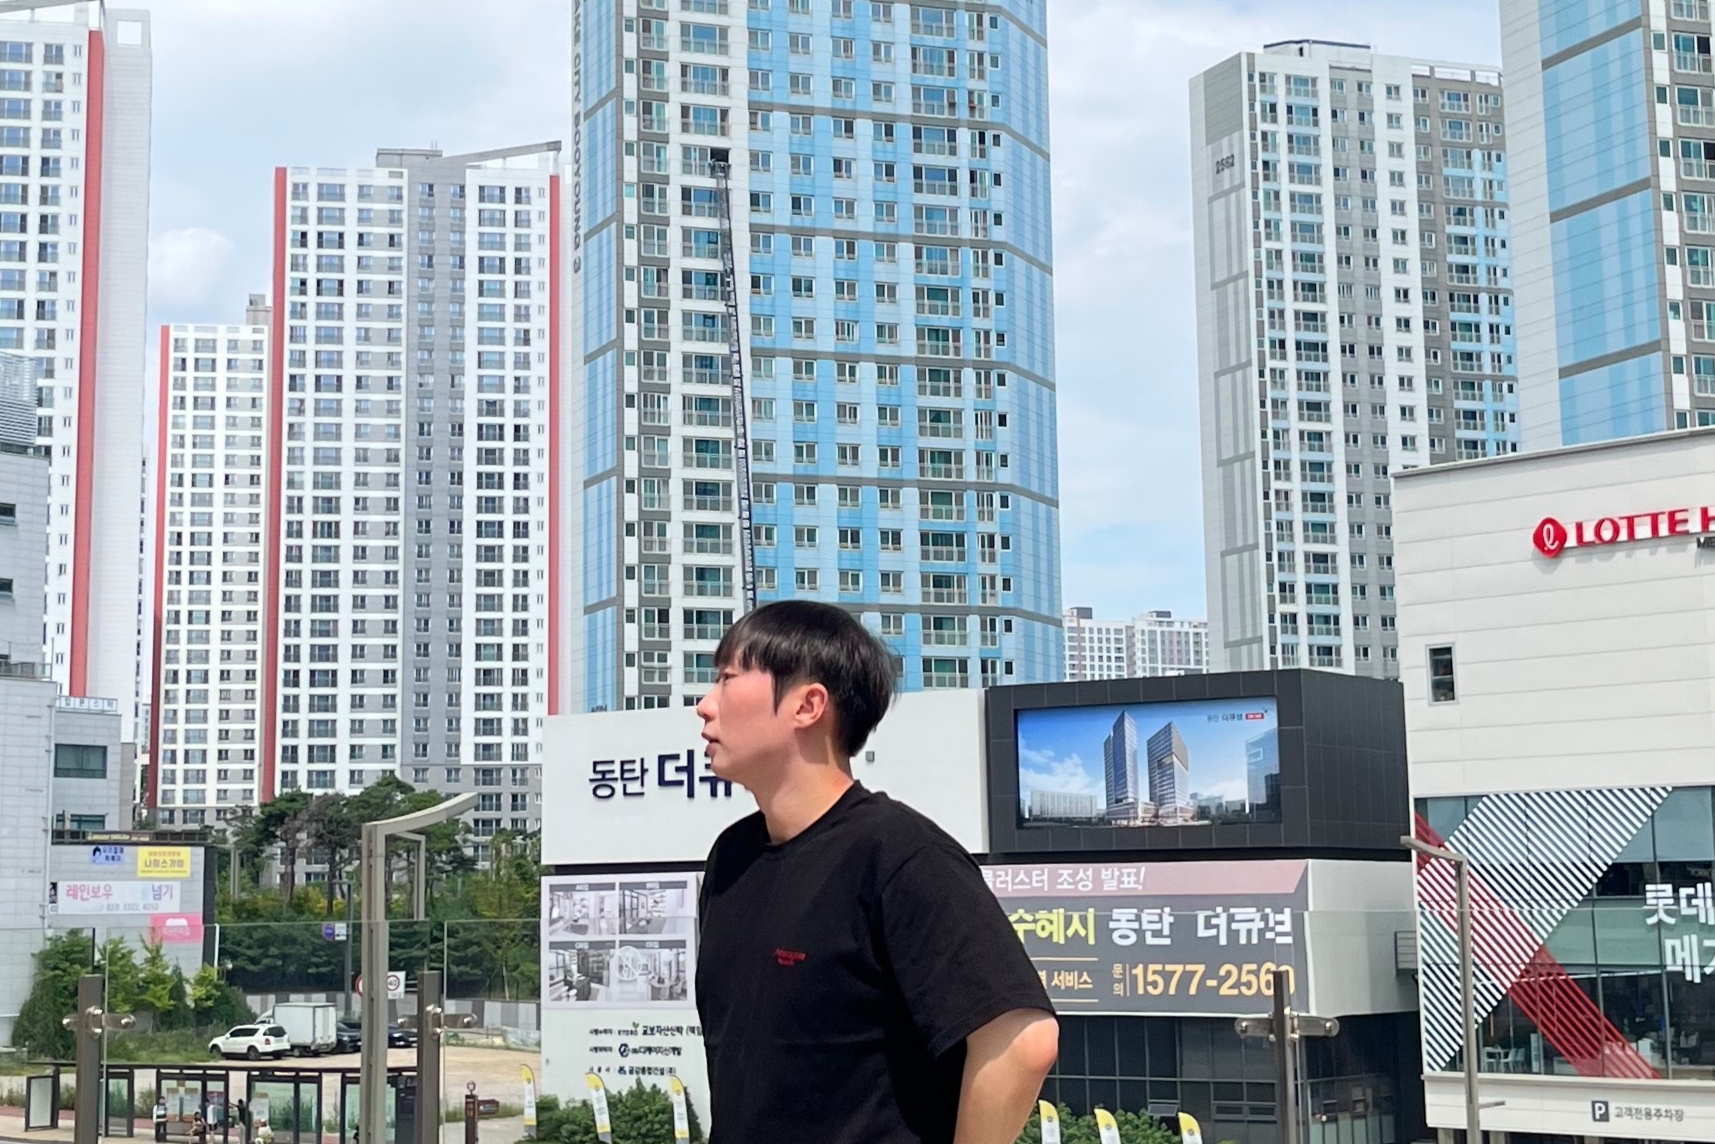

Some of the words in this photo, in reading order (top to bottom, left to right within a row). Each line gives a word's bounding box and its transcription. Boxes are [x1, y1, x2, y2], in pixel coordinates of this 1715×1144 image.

[1575, 508, 1689, 546] LOTTE
[589, 757, 648, 799] 동탄
[66, 883, 114, 901] 레인보우
[1056, 866, 1094, 892] 조성
[1101, 865, 1146, 891] 발표!
[1643, 882, 1715, 926] 롯데
[1109, 907, 1174, 946] 동탄
[1196, 906, 1293, 946] 더큐브
[1051, 970, 1094, 991] 서비스
[1614, 1106, 1684, 1122] 고객전용주차장
